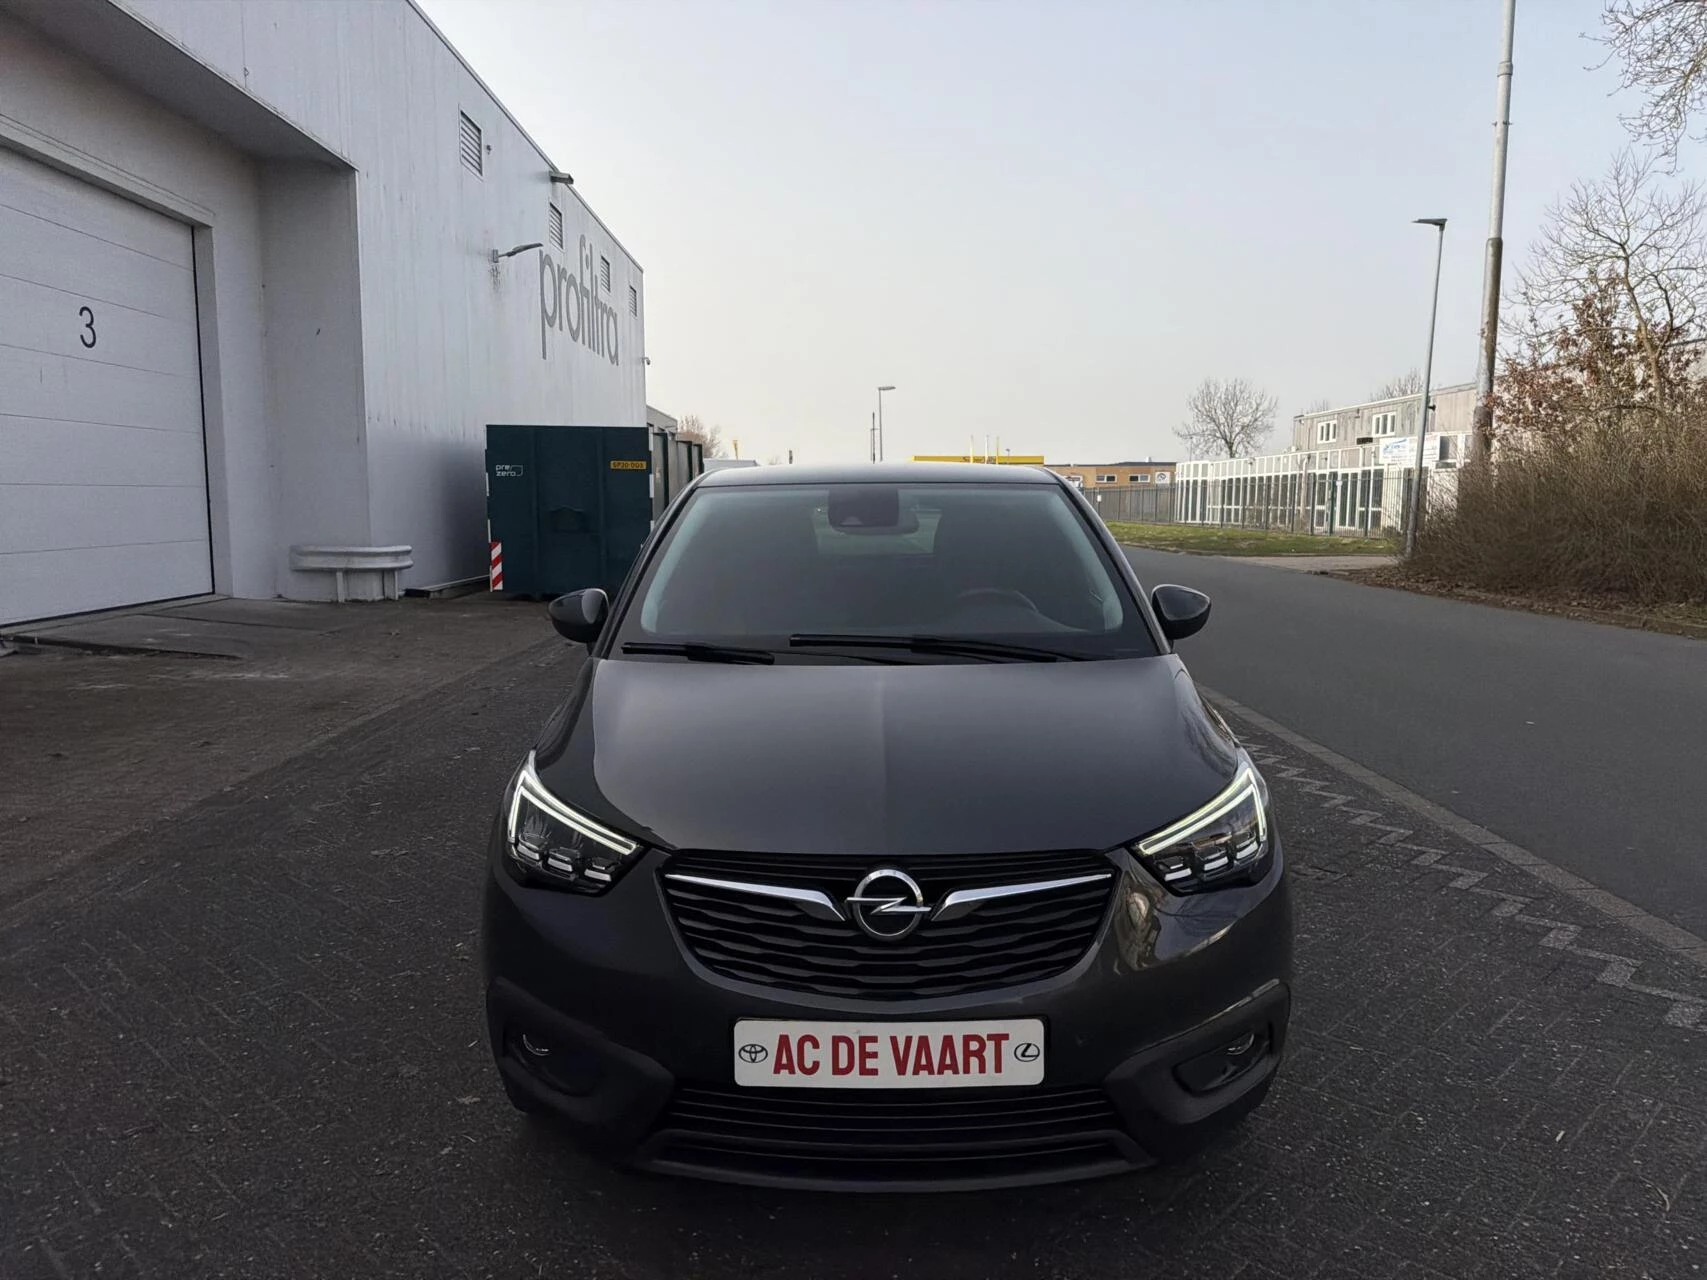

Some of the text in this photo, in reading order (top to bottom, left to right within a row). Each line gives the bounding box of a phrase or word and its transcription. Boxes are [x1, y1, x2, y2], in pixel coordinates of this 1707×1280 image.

[539, 234, 619, 366] profiltra
[79, 306, 96, 348] 3
[773, 1033, 1010, 1076] AC DE VAART
